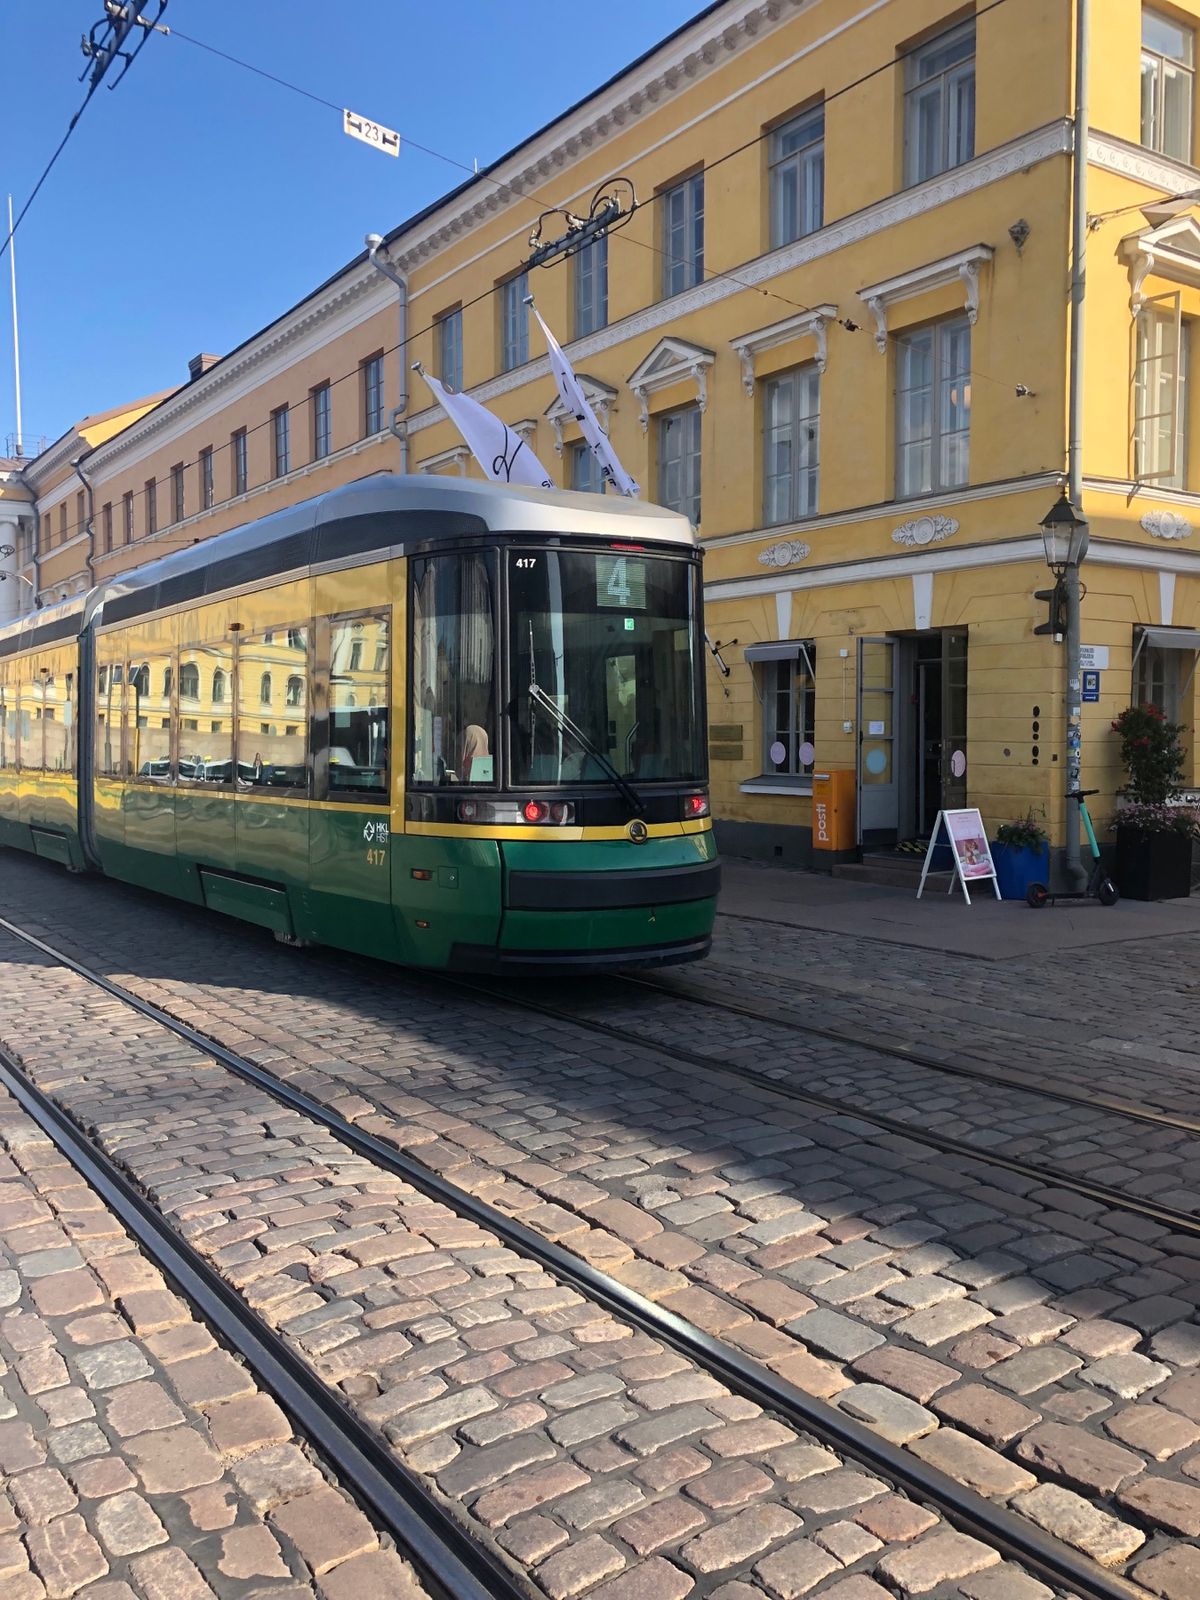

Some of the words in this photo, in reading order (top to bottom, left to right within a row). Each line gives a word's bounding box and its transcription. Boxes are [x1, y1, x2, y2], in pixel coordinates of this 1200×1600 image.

[365, 122, 379, 142] 23
[515, 558, 537, 568] 417
[607, 557, 631, 606] 4
[376, 822, 389, 833] HKL
[816, 803, 830, 842] posti
[376, 832, 389, 844] HST
[367, 848, 386, 866] 417
